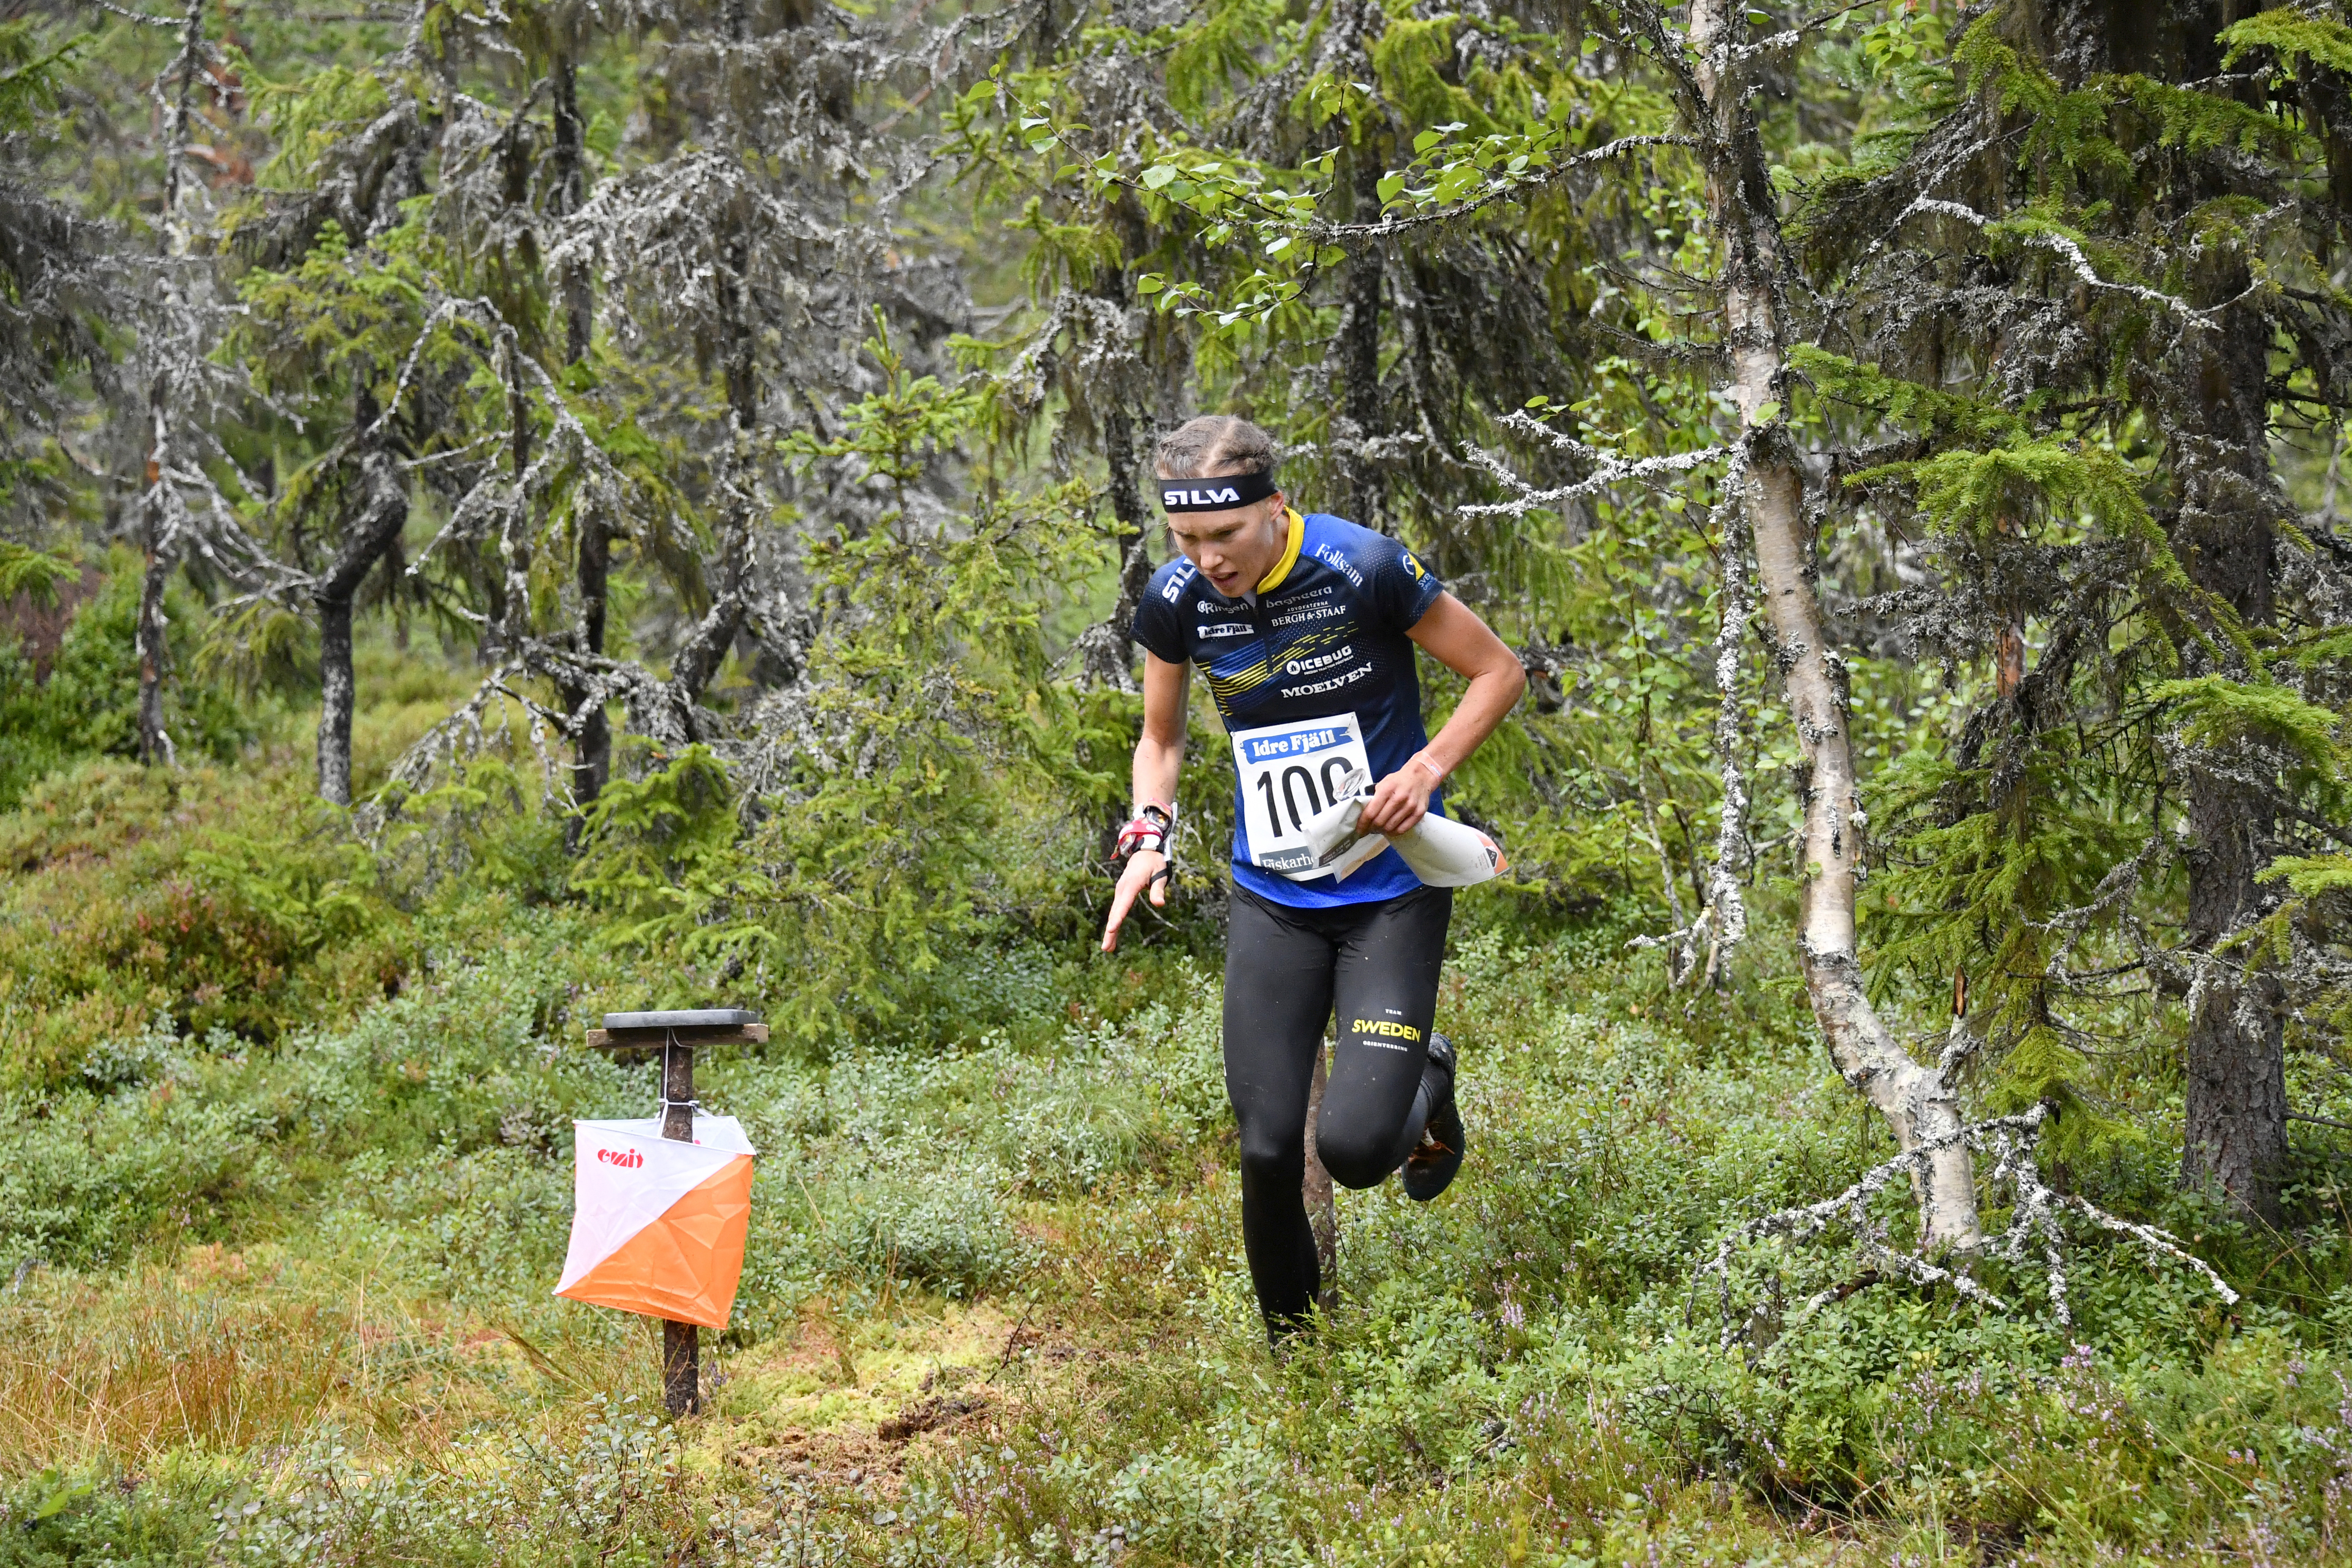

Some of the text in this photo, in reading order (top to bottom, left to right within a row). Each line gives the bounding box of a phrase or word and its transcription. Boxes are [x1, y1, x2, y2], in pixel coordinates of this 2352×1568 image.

[1164, 488, 1240, 505] SILVA
[1315, 543, 1363, 587] Folksam
[1266, 586, 1332, 608] bagheera
[1287, 601, 1328, 612] ADVOKATERNA
[1271, 612, 1306, 627] BERGH
[1316, 605, 1346, 618] STAAF
[1204, 625, 1247, 636] Idre Fjäll
[1300, 645, 1352, 670] ICEBUG
[1318, 663, 1335, 672] TRACTION
[1335, 655, 1354, 666] FOOTWEAR
[1281, 662, 1372, 698] MOELVEN
[1252, 730, 1336, 757] Idre Fjäll
[1262, 853, 1314, 871] Fiskarh
[1352, 1019, 1421, 1043] SWEDEN
[1363, 1040, 1407, 1052] ORIENTEERING
[598, 1149, 643, 1168] emit
